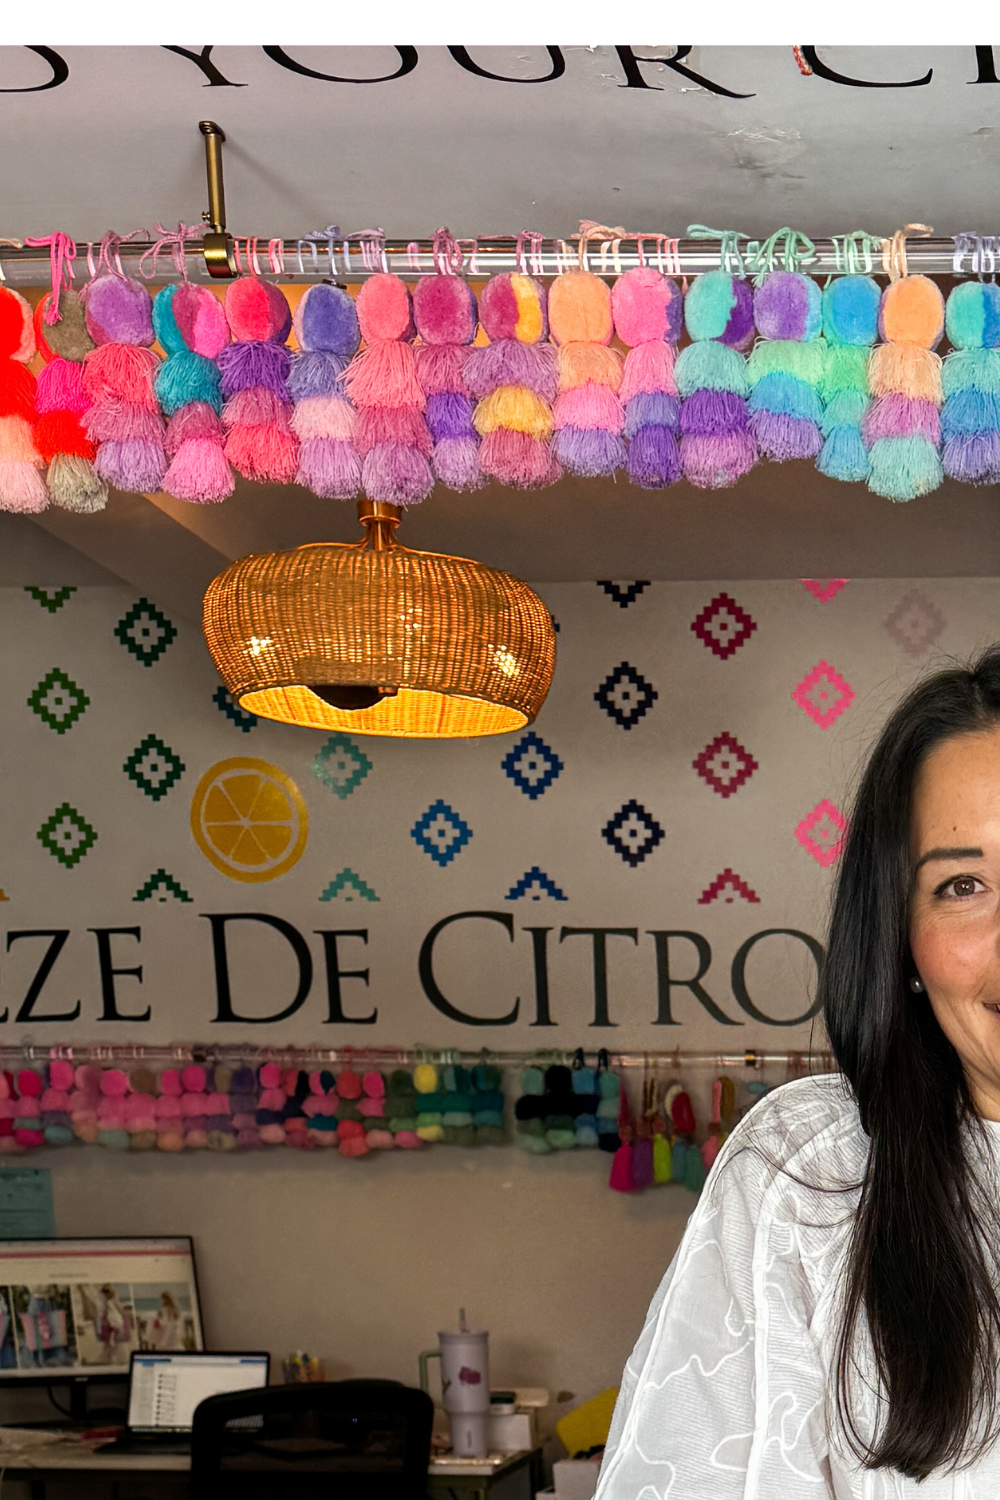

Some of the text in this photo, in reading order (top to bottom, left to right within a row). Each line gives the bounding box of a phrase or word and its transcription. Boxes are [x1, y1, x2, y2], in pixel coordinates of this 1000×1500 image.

[0, 910, 828, 1028] ZE DE CITRO
